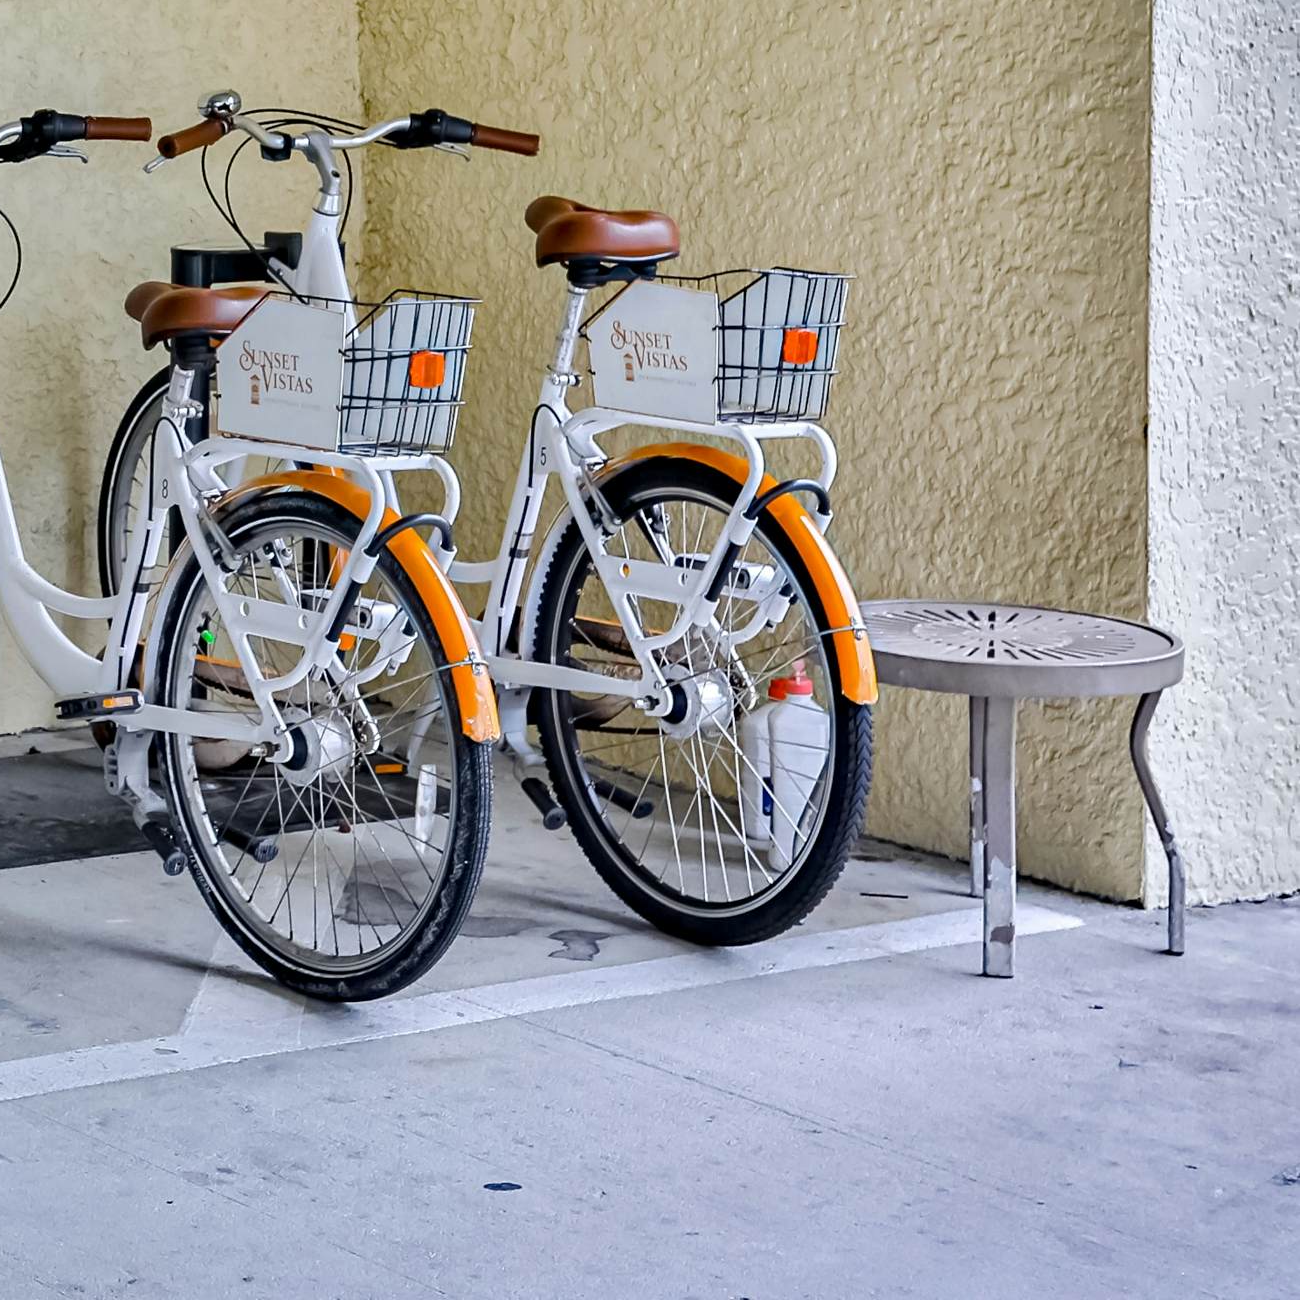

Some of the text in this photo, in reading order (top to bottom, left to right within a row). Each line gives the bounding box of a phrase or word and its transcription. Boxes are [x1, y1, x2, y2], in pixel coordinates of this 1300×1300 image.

[610, 320, 672, 350] SUNSET
[239, 340, 299, 371] SUNSET
[633, 343, 688, 371] VISTAS
[260, 364, 313, 394] VISTAS
[541, 446, 547, 466] 5
[162, 478, 168, 499] 8
